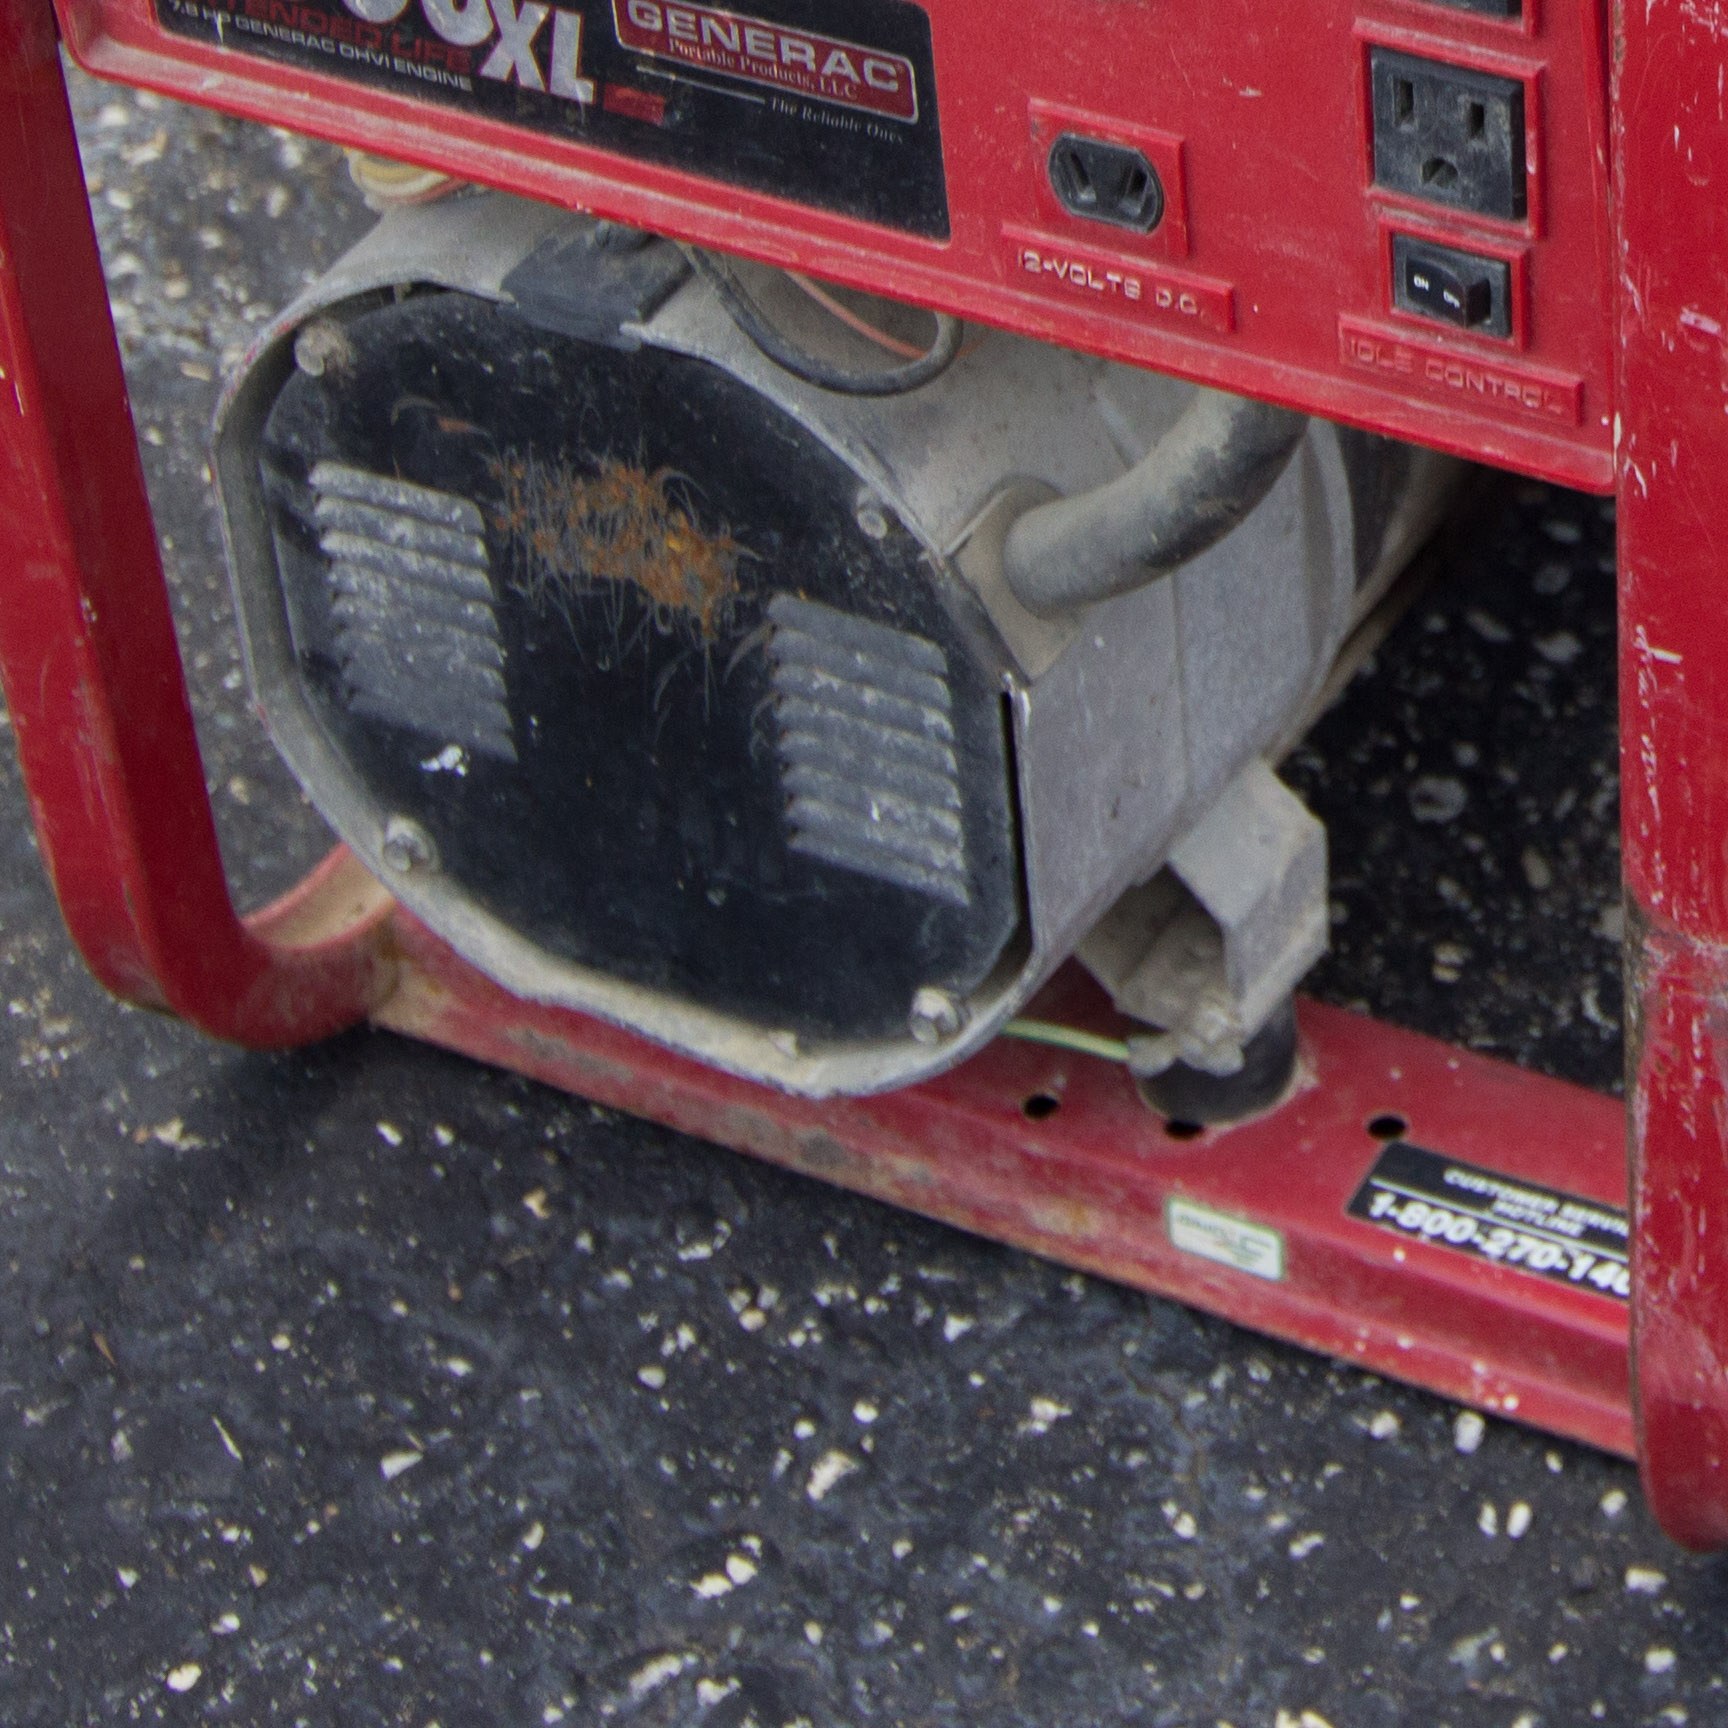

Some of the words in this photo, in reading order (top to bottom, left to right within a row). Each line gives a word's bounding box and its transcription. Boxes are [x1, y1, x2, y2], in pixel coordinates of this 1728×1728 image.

[202, 5, 231, 22] HP
[234, 15, 335, 53] GENERAC
[394, 57, 472, 92] ENGINE
[391, 31, 472, 75] LIFE
[668, 37, 735, 69] Portable
[818, 75, 858, 100] LLC
[772, 97, 797, 116] The
[802, 107, 862, 132] Reliable
[1425, 357, 1562, 415] CONTROL
[1443, 1169, 1559, 1214] CUSTOMER
